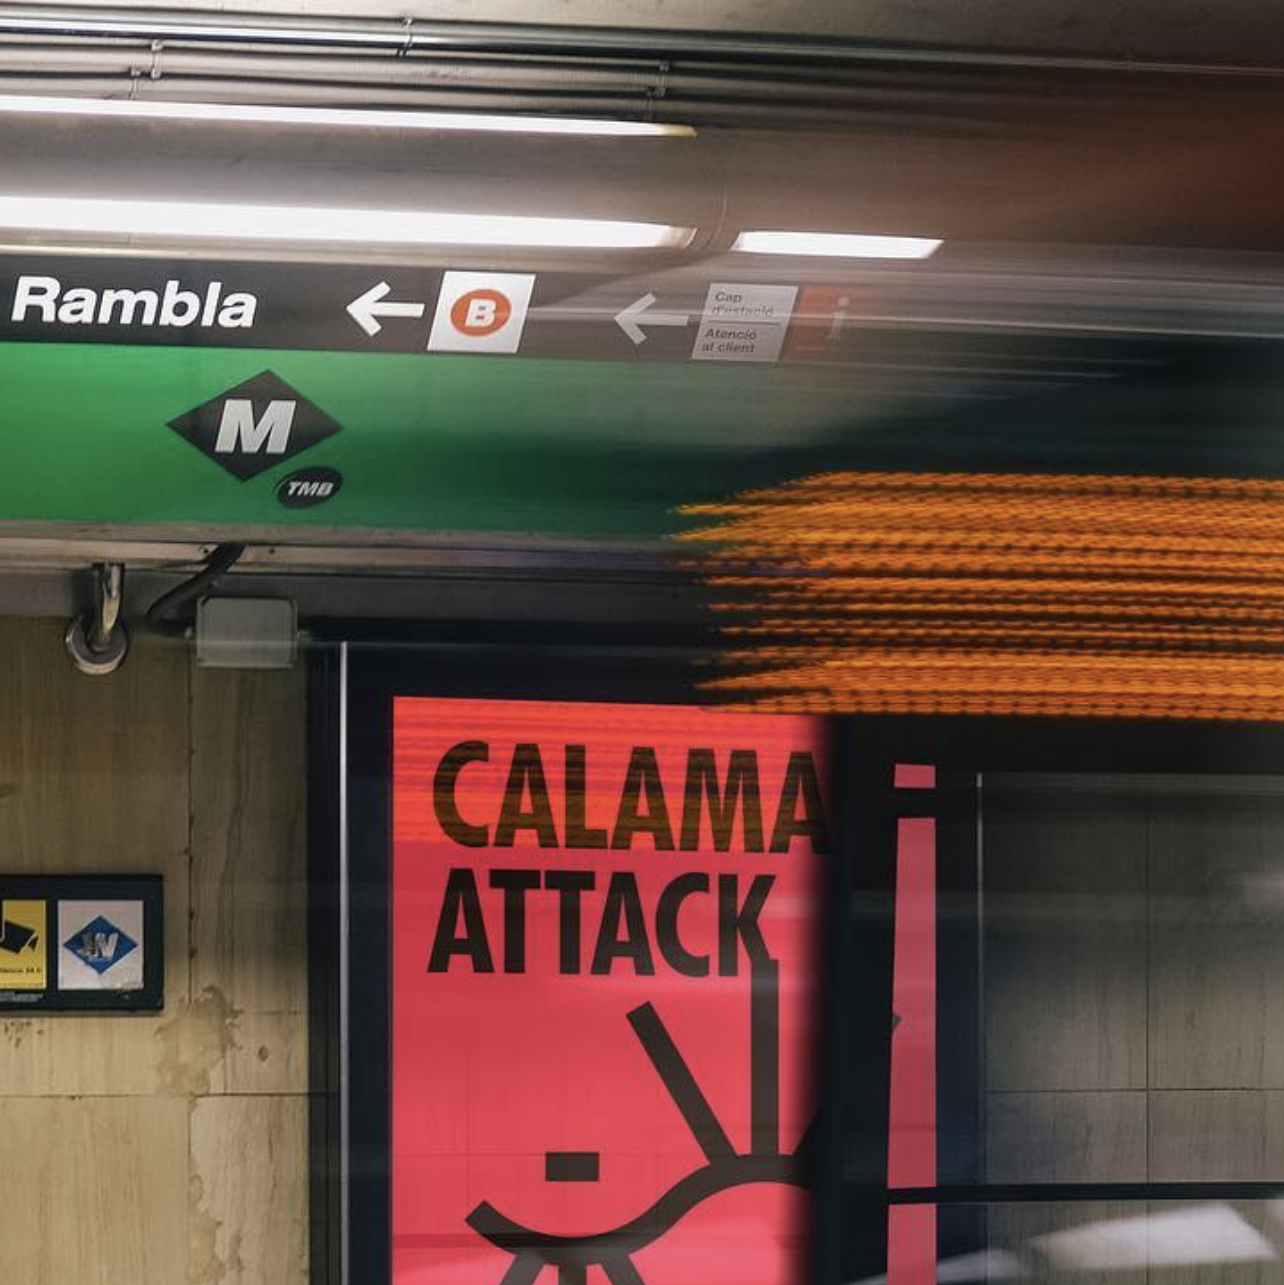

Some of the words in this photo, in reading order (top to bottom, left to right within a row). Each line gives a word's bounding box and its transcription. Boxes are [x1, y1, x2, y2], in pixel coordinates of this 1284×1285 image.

[10, 275, 258, 328] Rambla
[464, 298, 497, 328] B
[214, 399, 297, 455] M
[287, 480, 335, 497] TMB
[432, 739, 830, 855] CALAMA
[427, 867, 778, 978] ATTACK
